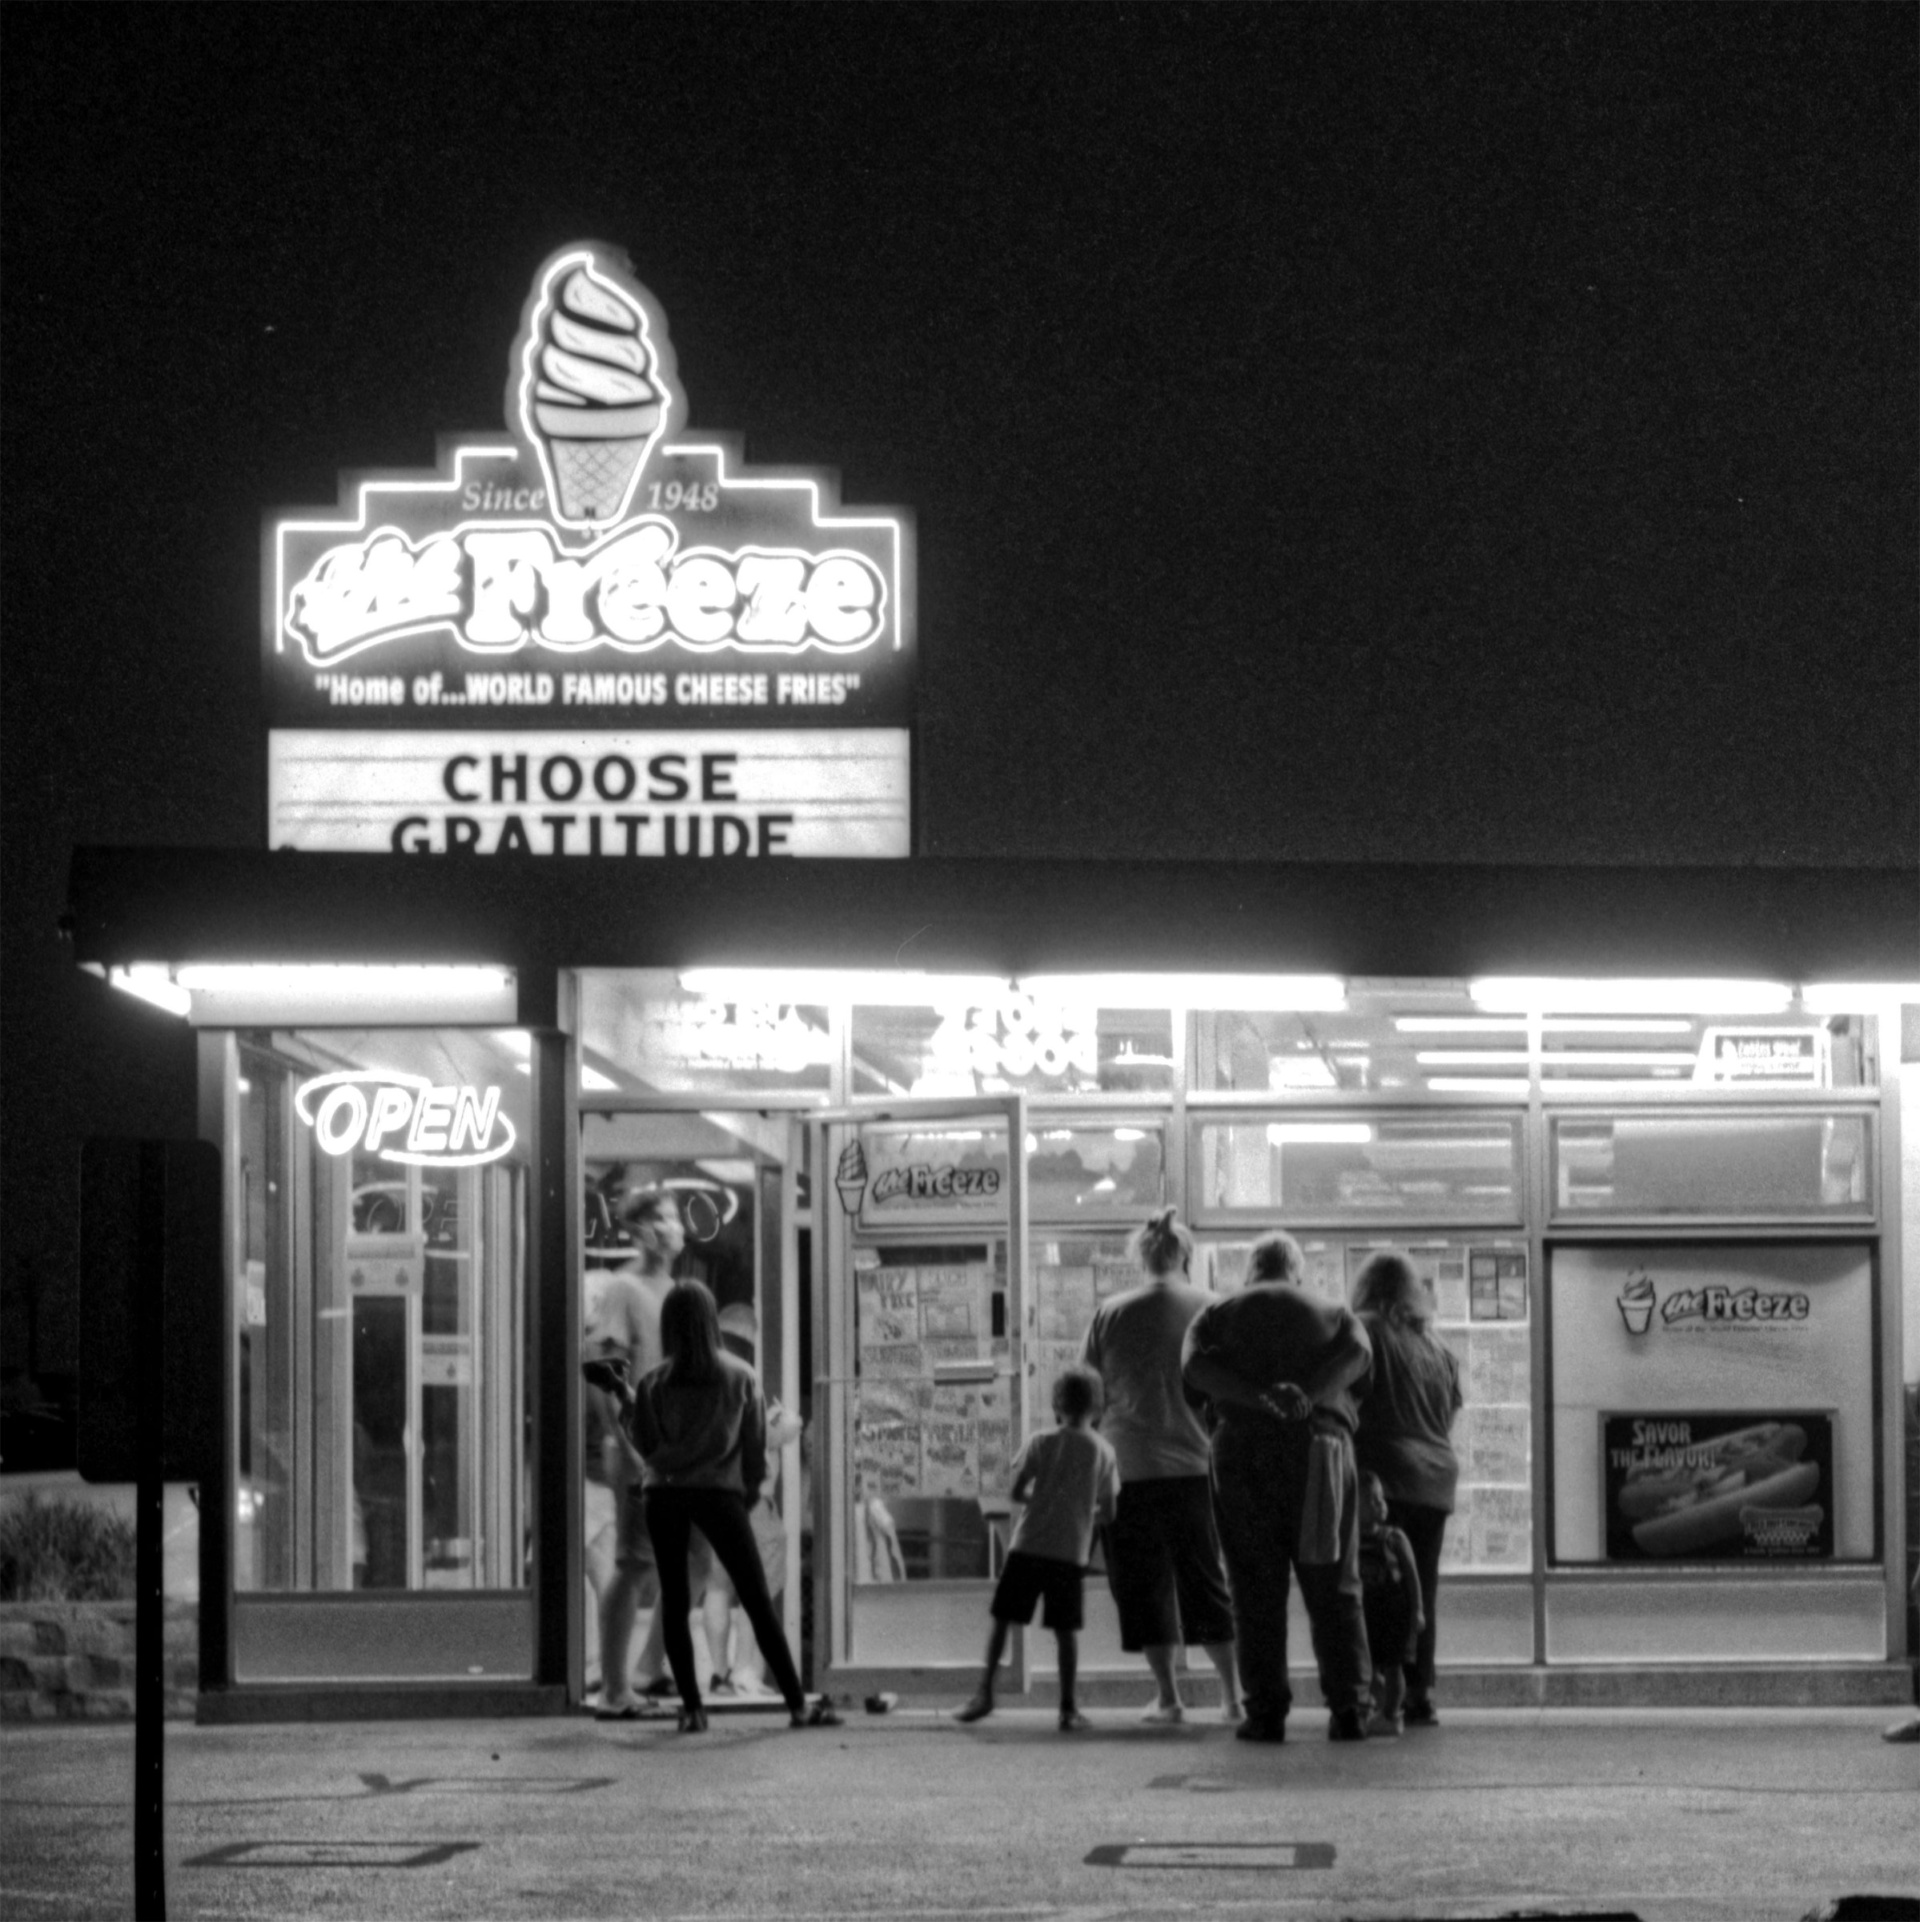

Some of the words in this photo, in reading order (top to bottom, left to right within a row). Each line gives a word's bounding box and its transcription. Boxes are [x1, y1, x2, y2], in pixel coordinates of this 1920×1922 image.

[461, 481, 545, 511] Since
[647, 481, 719, 512] 1948
[464, 524, 874, 643] Freeze
[315, 672, 404, 705] "Home
[562, 672, 667, 705] FAMOUS
[675, 672, 768, 705] CHEESE
[777, 672, 860, 705] FRIES"
[443, 754, 737, 801] CHOOSE
[391, 814, 793, 857] GRATITUDE
[316, 1084, 500, 1156] OPEN
[908, 1164, 1000, 1198] Freeze
[1703, 1285, 1810, 1320] Freeze
